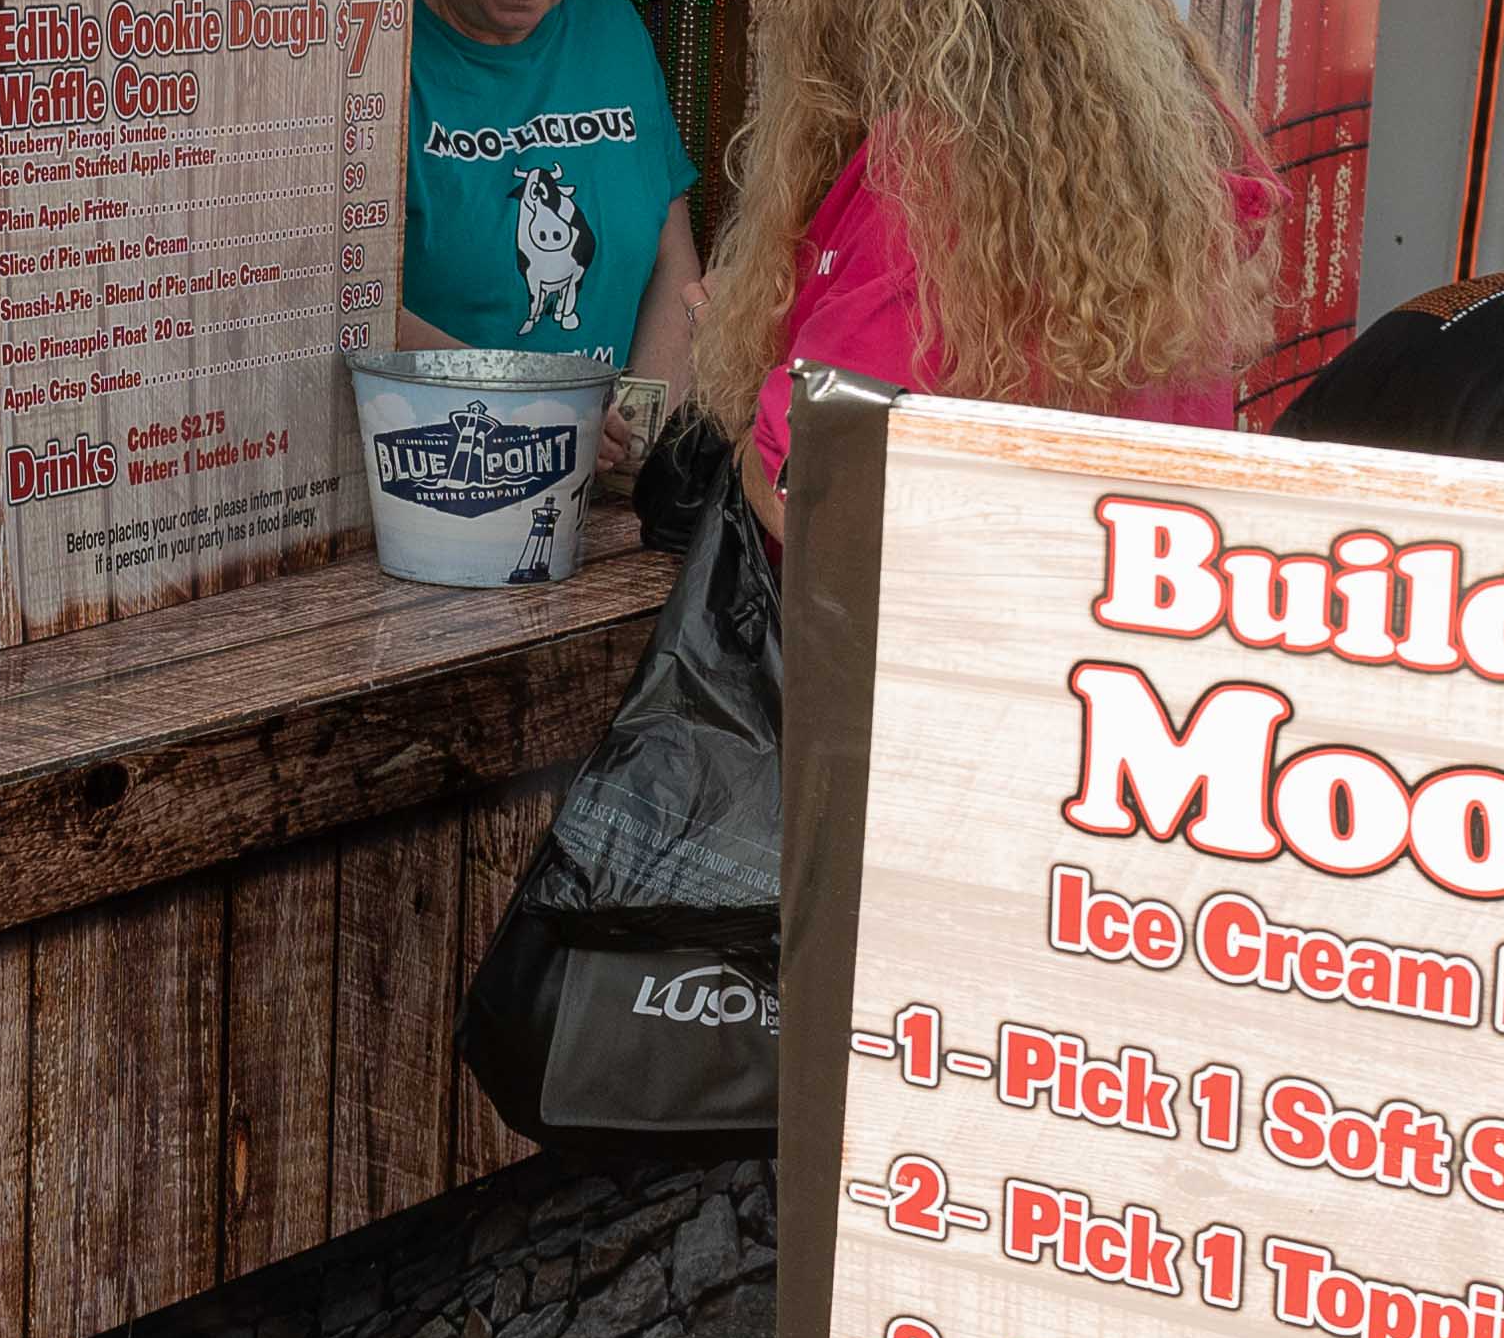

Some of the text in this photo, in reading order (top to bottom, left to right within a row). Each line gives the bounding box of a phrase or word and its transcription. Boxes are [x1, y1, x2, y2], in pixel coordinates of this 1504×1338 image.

[68, 131, 114, 155] Pierogi
[119, 123, 167, 143] Sundae
[424, 107, 636, 161] MOO-LICIOUS
[128, 411, 225, 451] Coffee $2.75
[377, 433, 570, 482] BLUE POINT
[7, 434, 117, 505] Drinks
[416, 487, 526, 501] BREWING COMPANY
[1048, 866, 1187, 973] Ice
[1199, 892, 1478, 1026] Cream
[997, 1023, 1175, 1139] Pick
[1192, 1068, 1241, 1151] 1
[1264, 1073, 1452, 1201] Soft
[1006, 1182, 1178, 1299] Pick
[1192, 1225, 1241, 1311] 1
